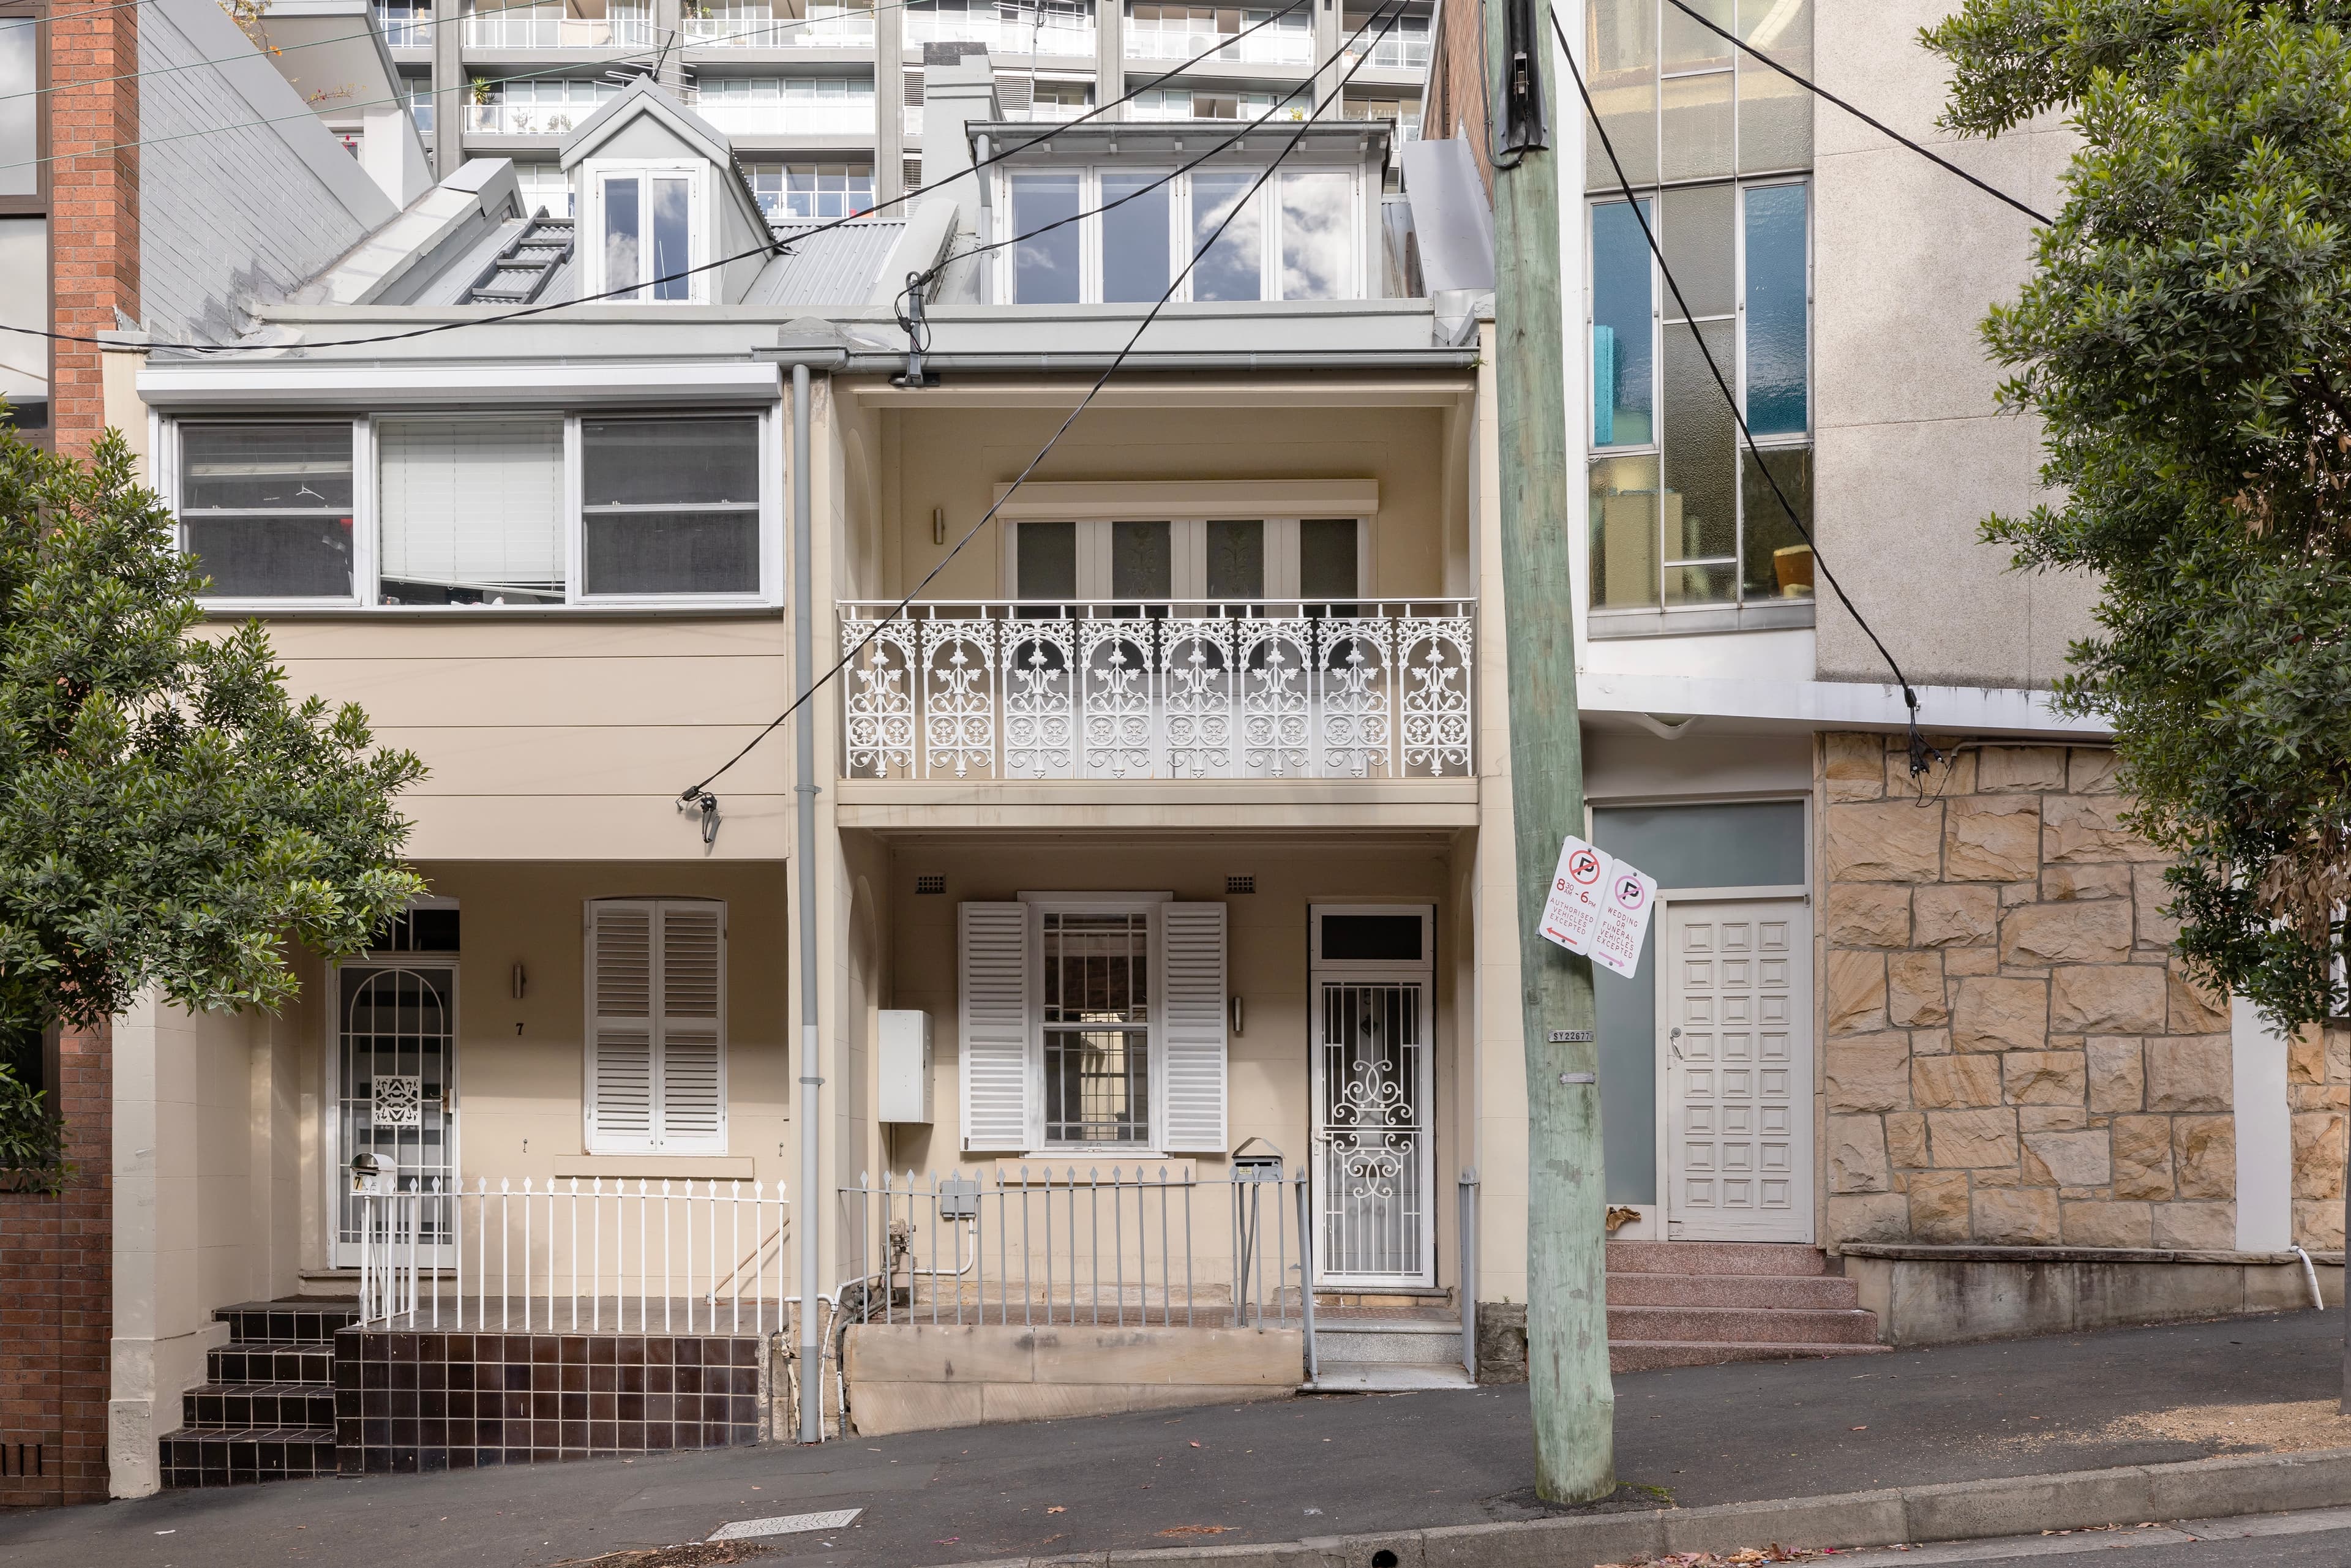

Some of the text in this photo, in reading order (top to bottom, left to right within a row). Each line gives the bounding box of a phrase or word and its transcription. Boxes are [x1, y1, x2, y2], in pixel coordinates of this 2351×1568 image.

[1550, 898, 1594, 923] AUTHORISED
[1553, 907, 1587, 928] VEHICLES
[1608, 906, 1638, 928] WEDDING
[1550, 913, 1586, 935] EXCEPTED
[1602, 921, 1634, 943] FUNERAL
[1616, 920, 1625, 929] OR
[1597, 936, 1633, 959] EXCEPTED
[1600, 929, 1634, 951] VEHICLES
[516, 1022, 524, 1035] 7
[355, 1177, 361, 1190] 7
